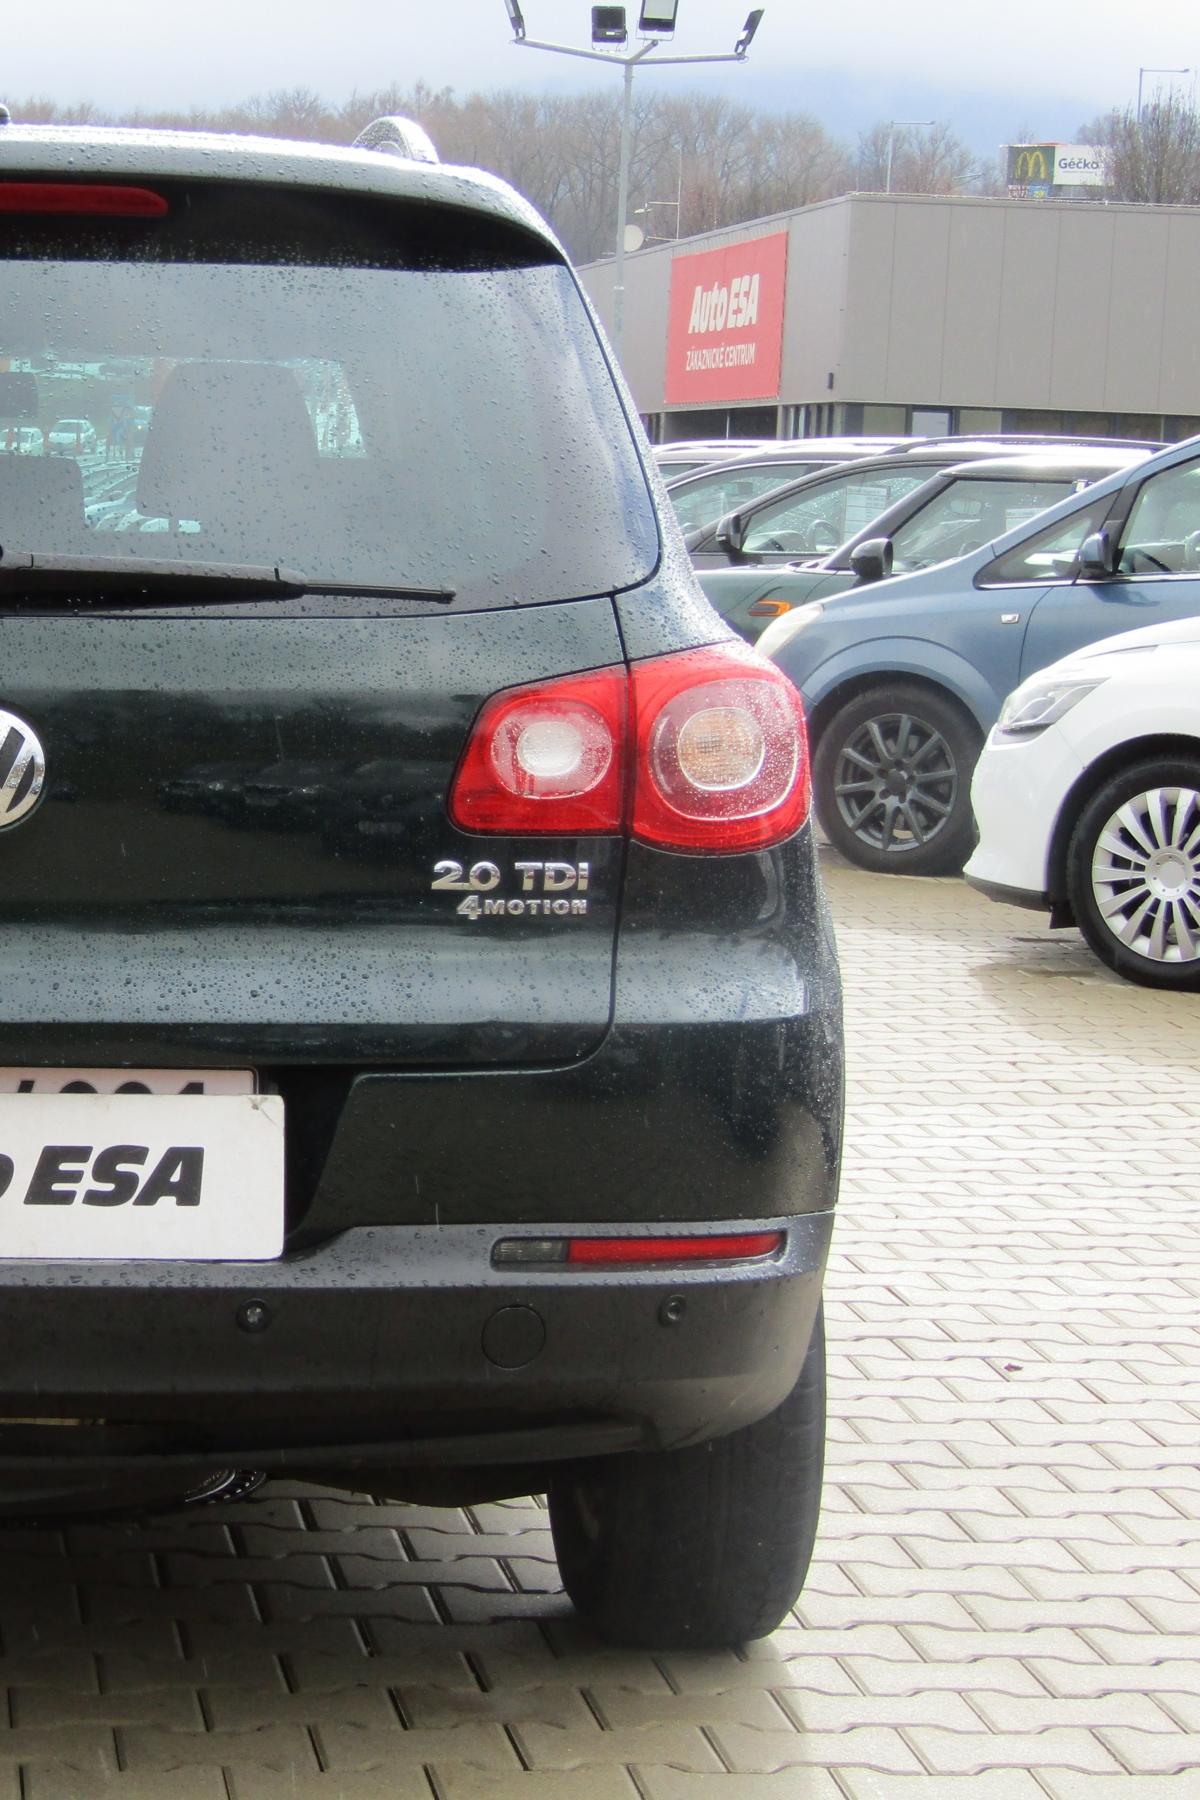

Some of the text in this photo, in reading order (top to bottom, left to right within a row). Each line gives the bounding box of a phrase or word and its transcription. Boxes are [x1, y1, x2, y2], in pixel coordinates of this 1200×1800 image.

[688, 273, 760, 334] Auto ESA
[686, 343, 756, 371] ZÁKAZNICKÉ CENTRUM
[514, 862, 589, 891] TDI
[456, 895, 587, 920] 4MOTION
[23, 1144, 205, 1207] ESA
